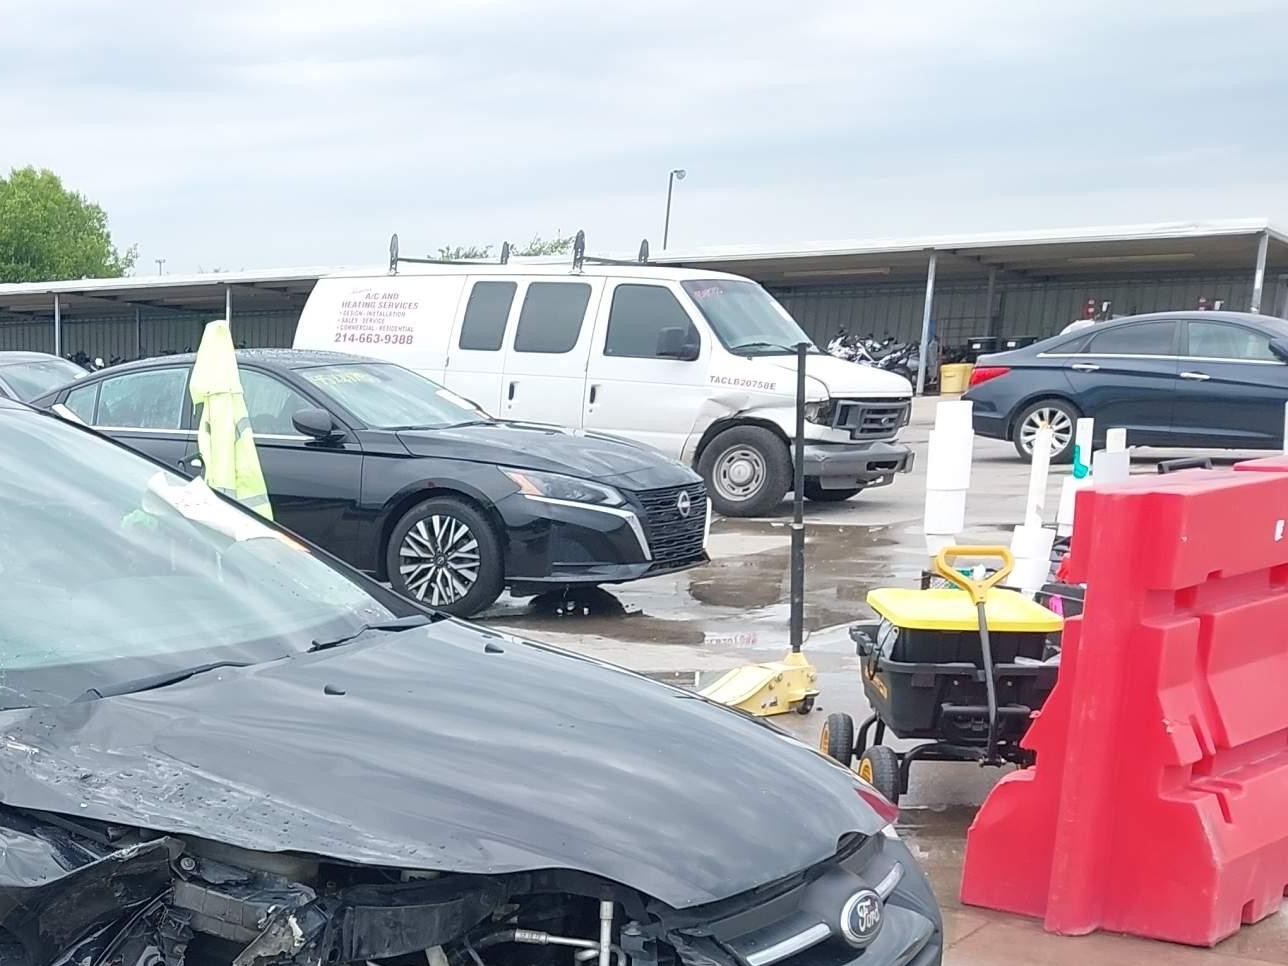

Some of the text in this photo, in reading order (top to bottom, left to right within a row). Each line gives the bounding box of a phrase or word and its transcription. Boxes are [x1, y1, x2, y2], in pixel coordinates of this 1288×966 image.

[341, 301, 419, 310] HEATING SERVICES
[334, 333, 414, 345] 214-663-9388
[857, 898, 881, 932] Ford
